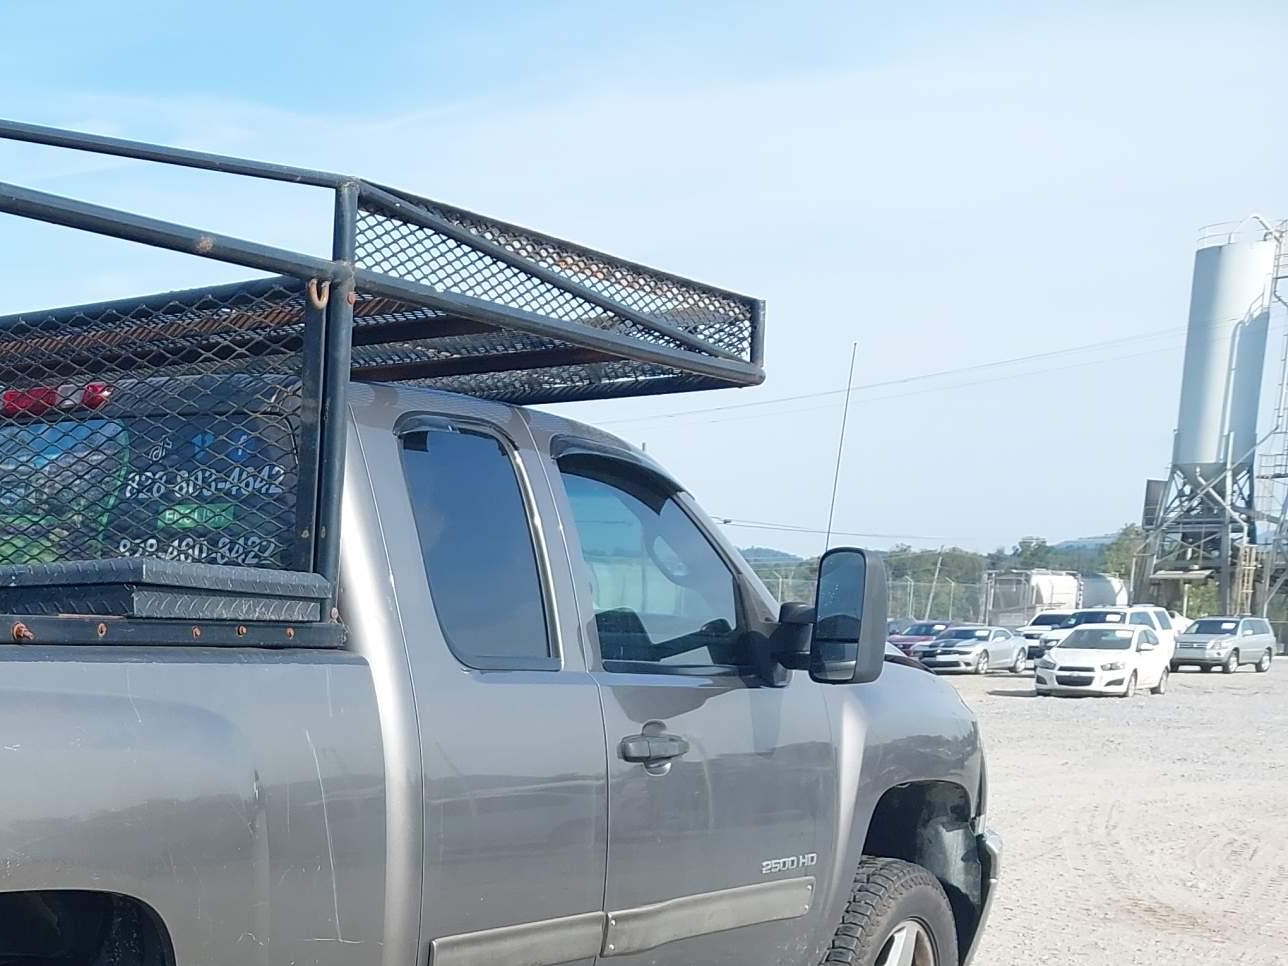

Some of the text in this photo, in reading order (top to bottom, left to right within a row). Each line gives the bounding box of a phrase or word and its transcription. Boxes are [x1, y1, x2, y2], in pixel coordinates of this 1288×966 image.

[125, 465, 285, 499] 828803-4642
[761, 853, 817, 873] 2500 HD
